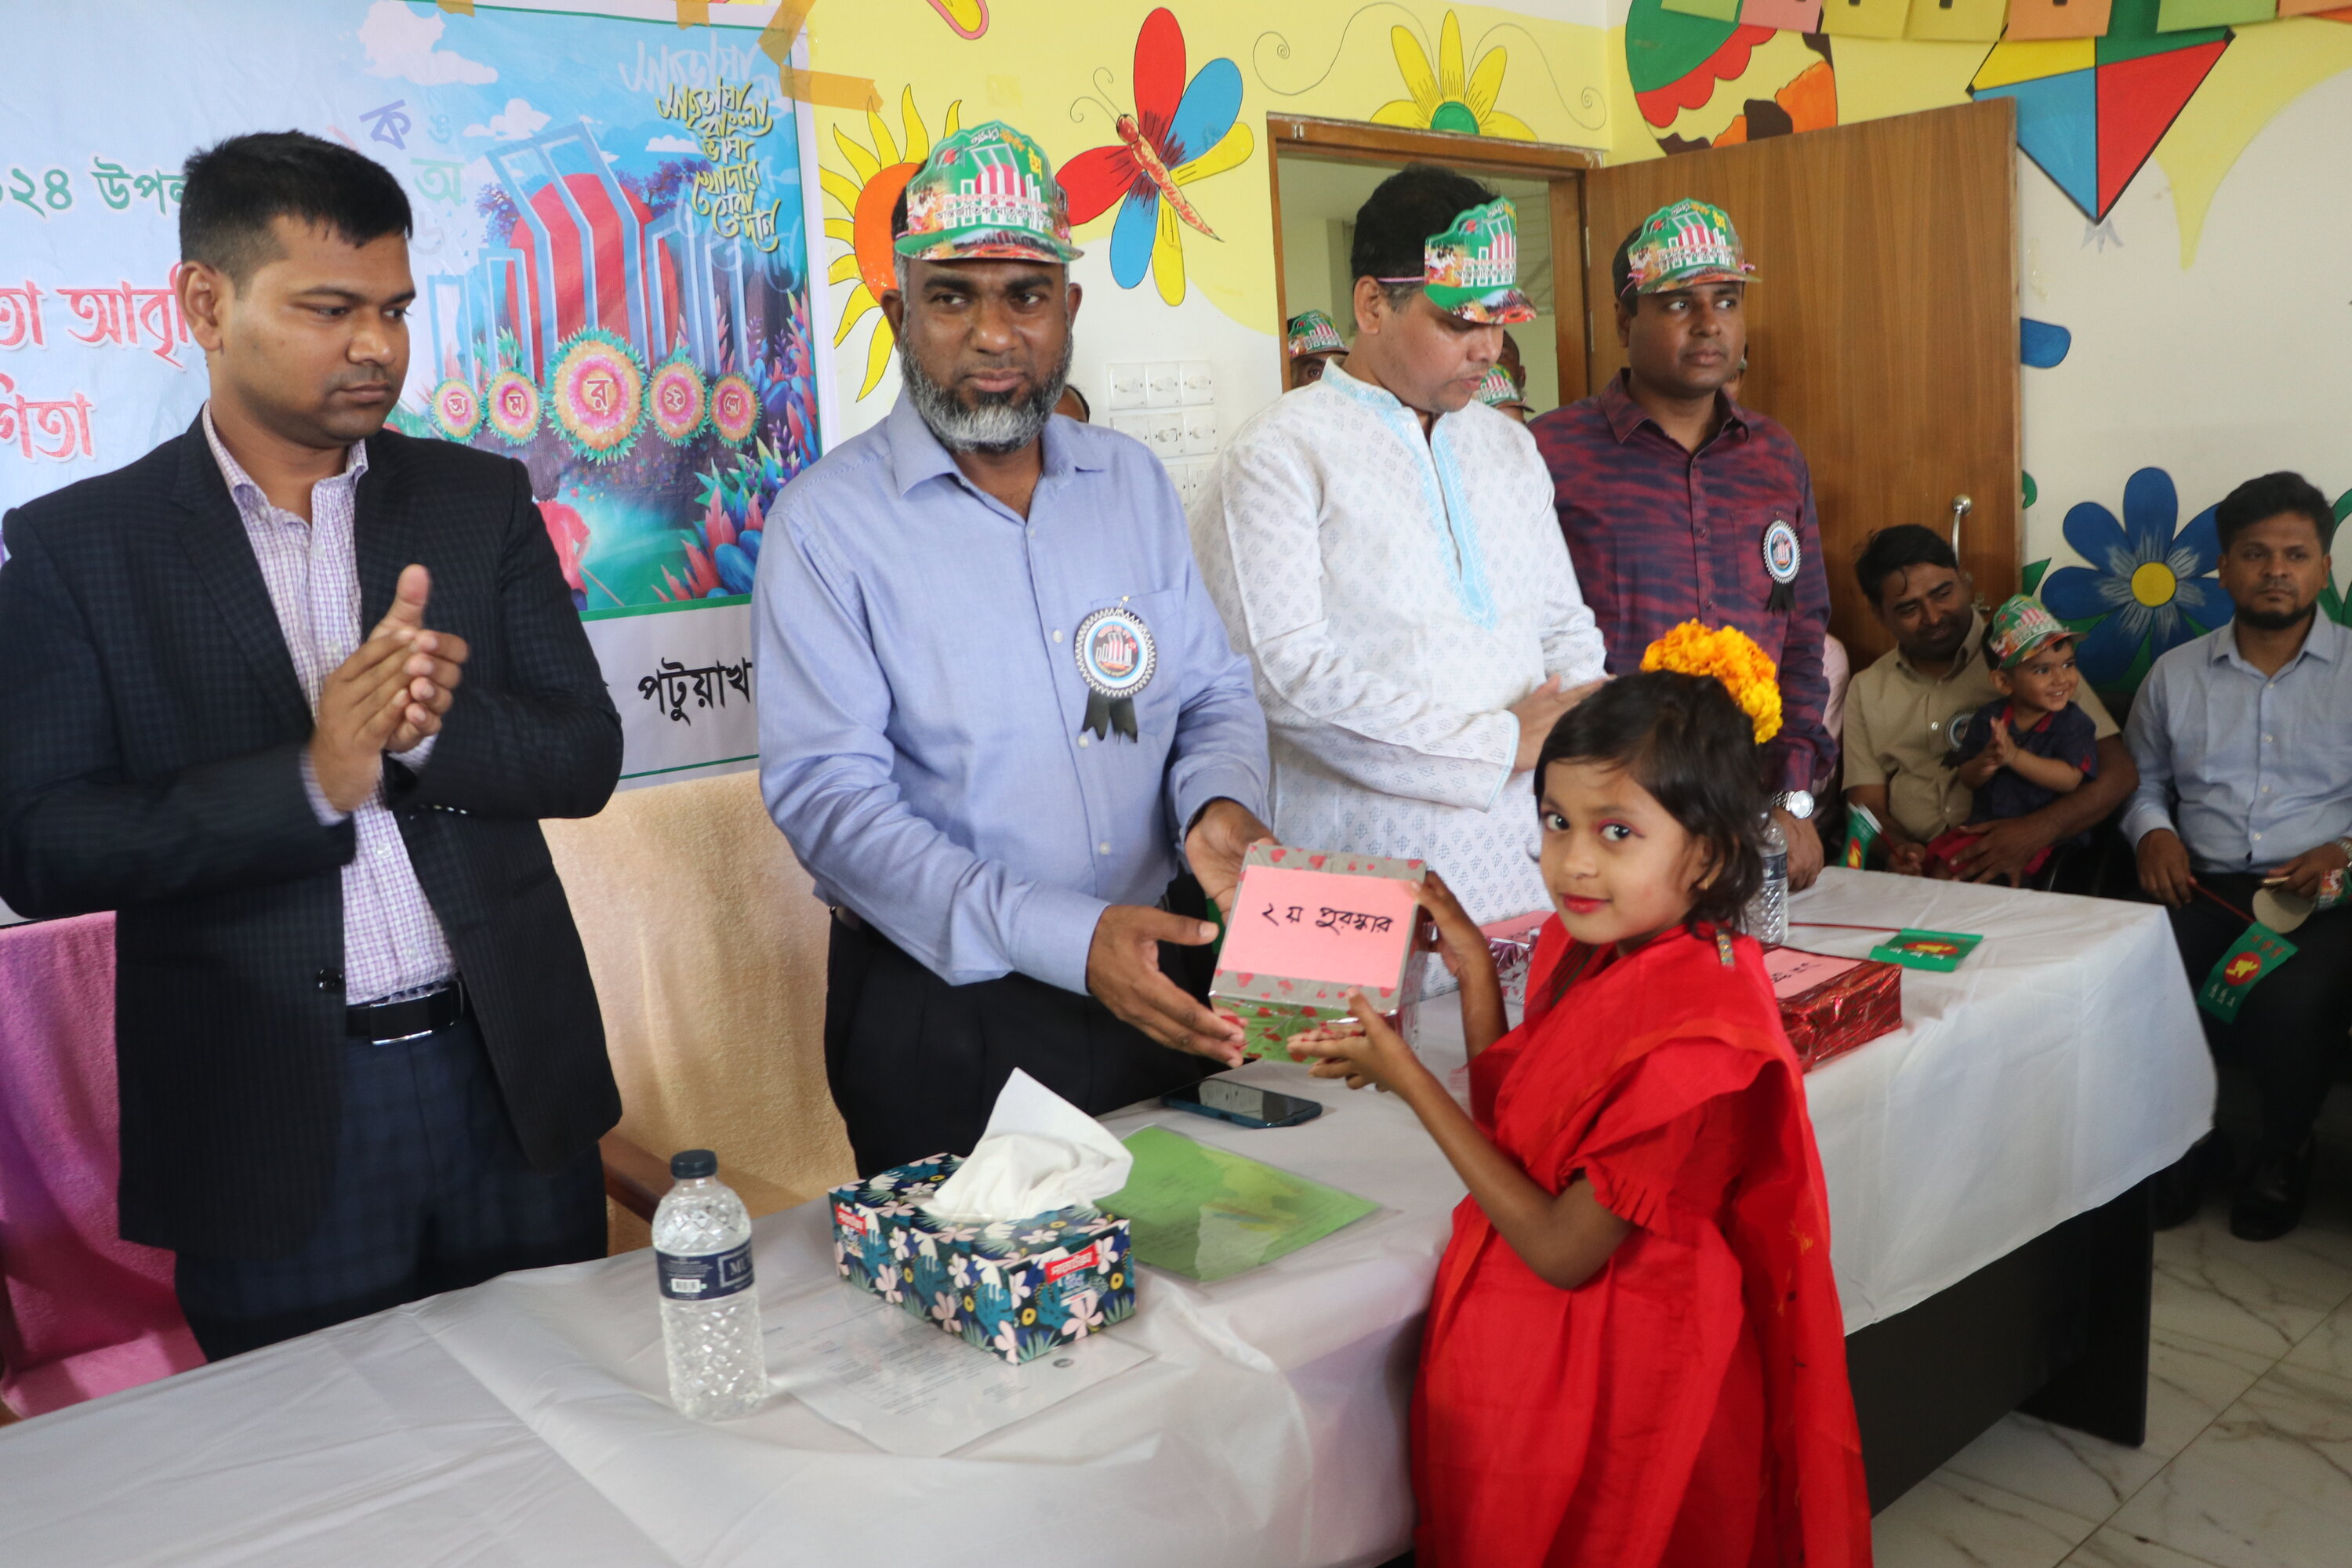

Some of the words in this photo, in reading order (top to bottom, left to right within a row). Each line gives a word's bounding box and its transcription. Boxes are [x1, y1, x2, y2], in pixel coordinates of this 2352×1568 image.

[358, 99, 412, 151] ক
[0, 167, 73, 219] ২৪
[410, 157, 466, 207] অ
[584, 378, 614, 412] র
